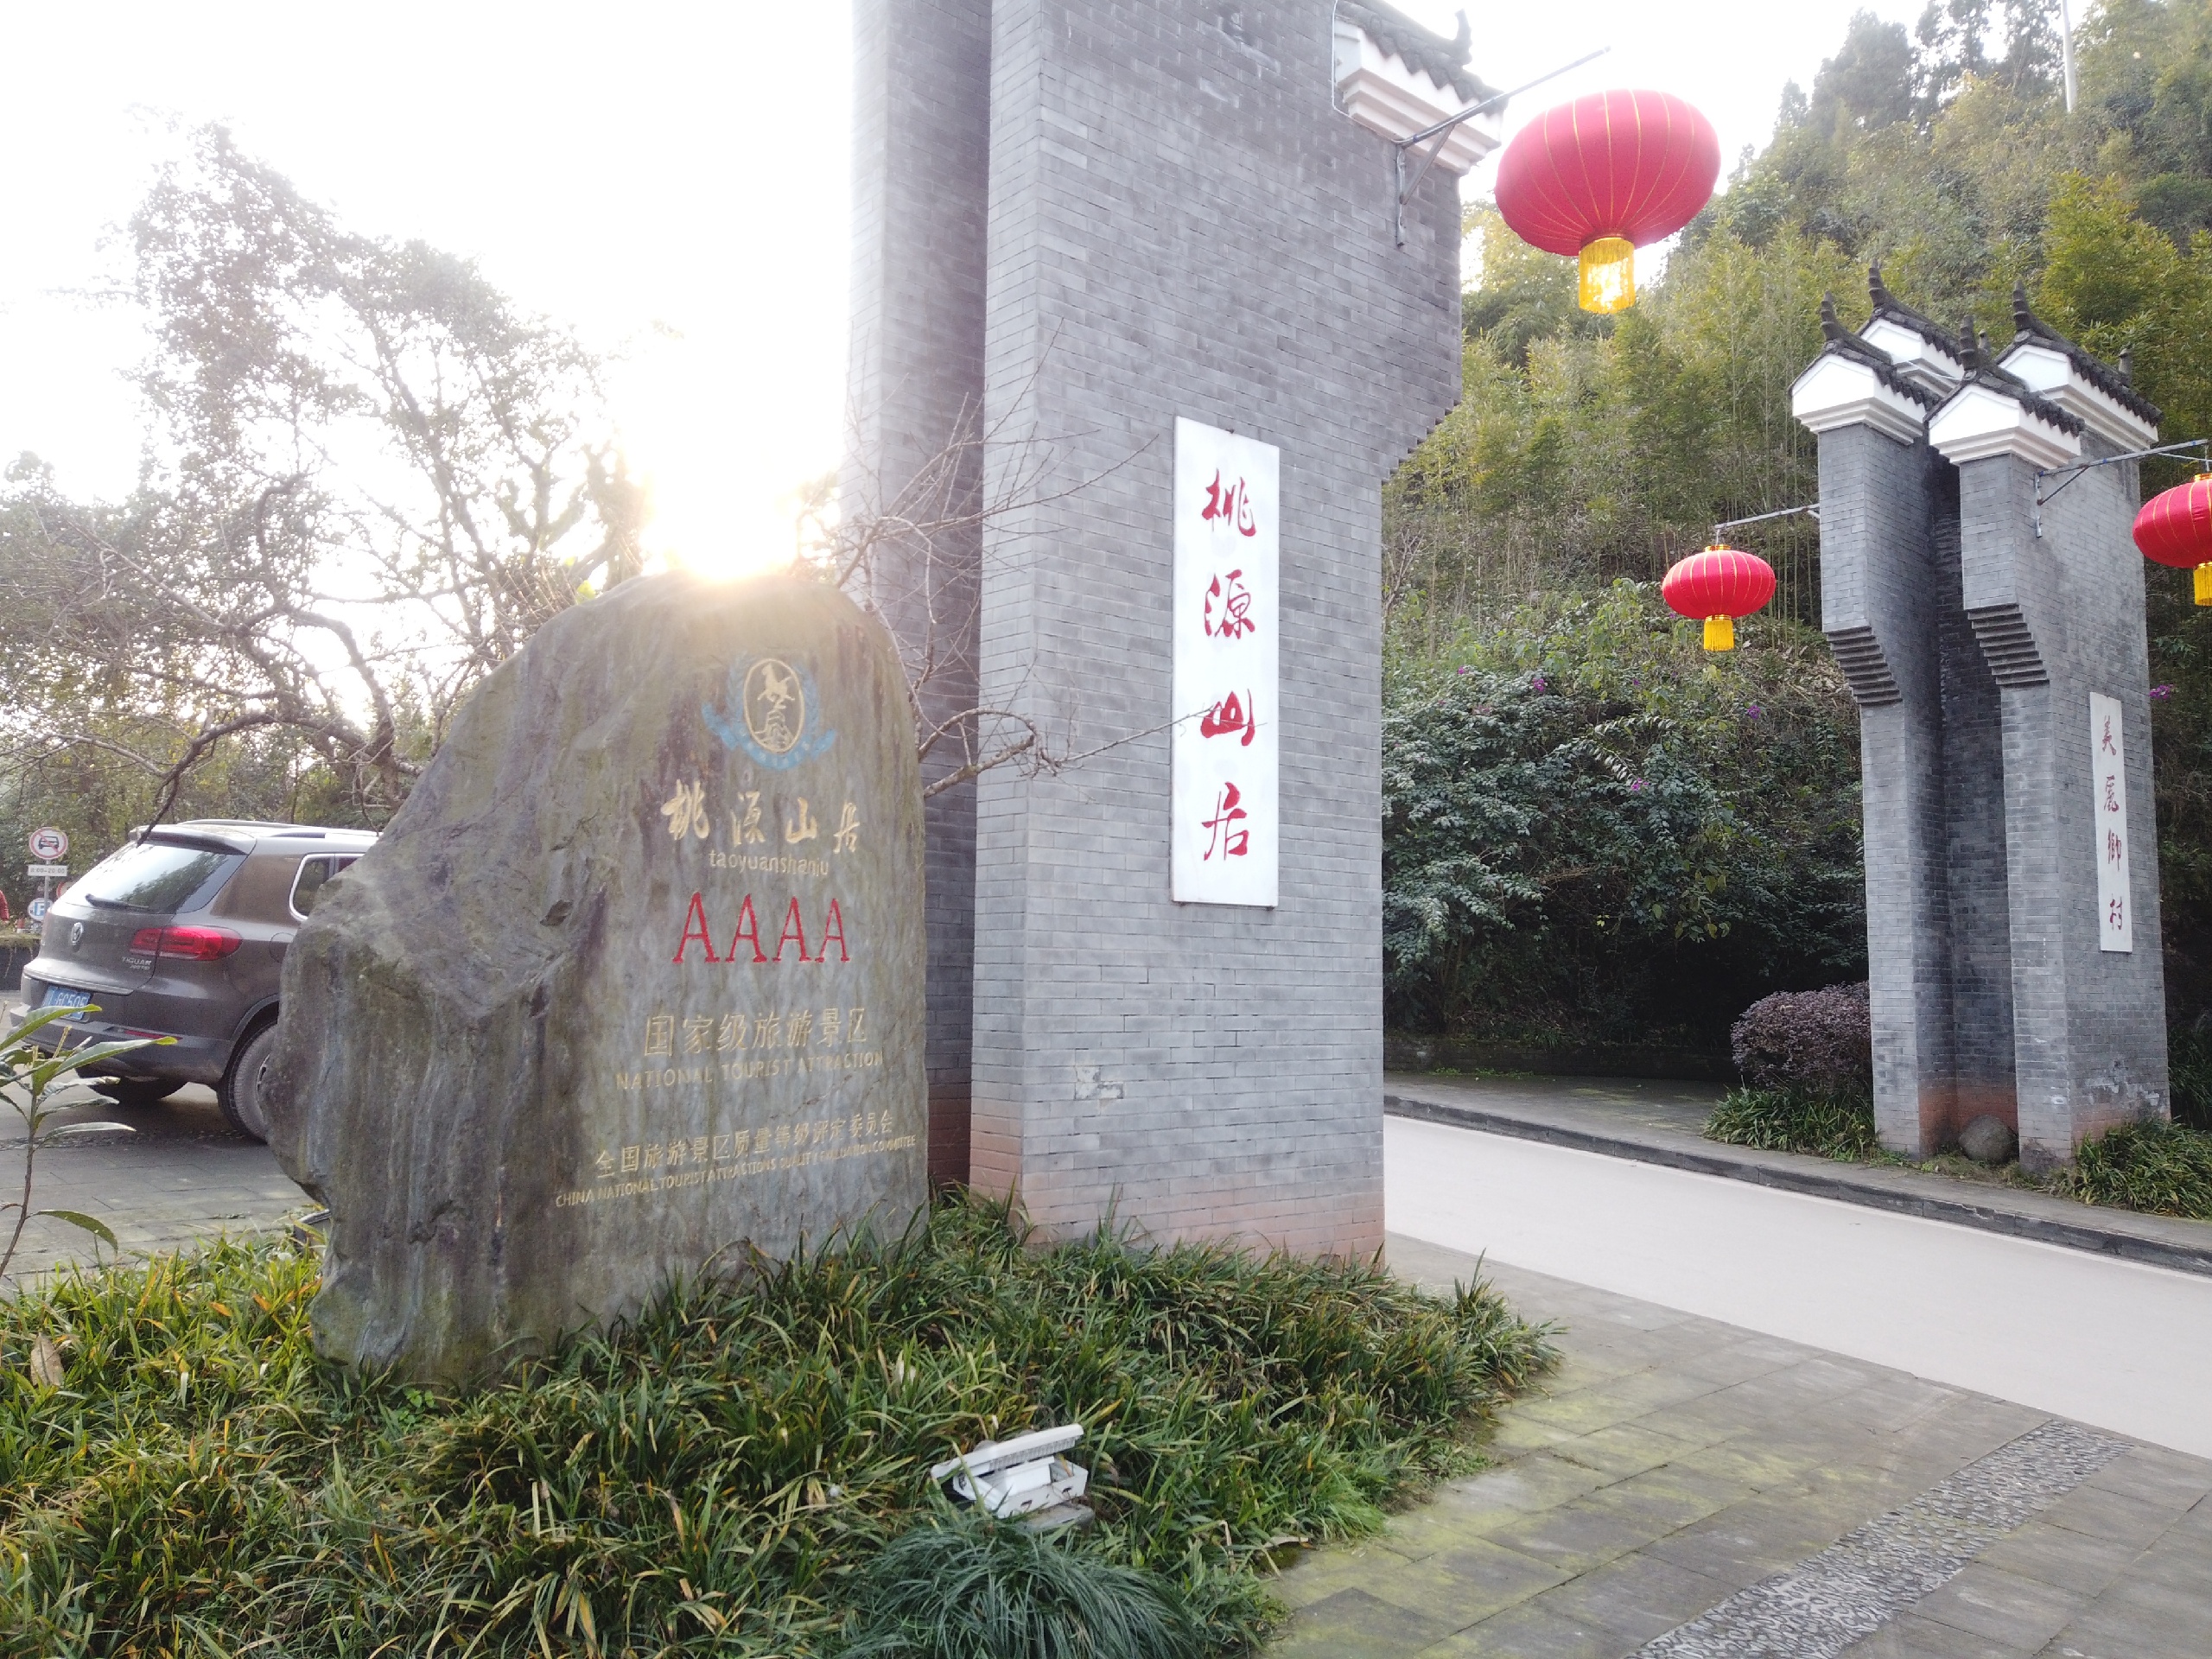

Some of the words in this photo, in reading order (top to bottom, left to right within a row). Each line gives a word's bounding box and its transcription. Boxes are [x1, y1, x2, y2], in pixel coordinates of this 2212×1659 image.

[1200, 467, 1256, 861] 桃源山居
[661, 779, 860, 855] 桃源山居
[672, 892, 850, 963] AAAA
[645, 1007, 866, 1056] 国家级旅游景区
[615, 1066, 713, 1090] NATIONAL
[721, 1059, 792, 1080] TOURIST
[798, 1051, 883, 1075] ATTRACTION
[595, 1109, 893, 1179] 全国旅游景区质量等级评定委员会
[556, 1189, 594, 1207] CHINA
[598, 1178, 659, 1199] NATIONAL
